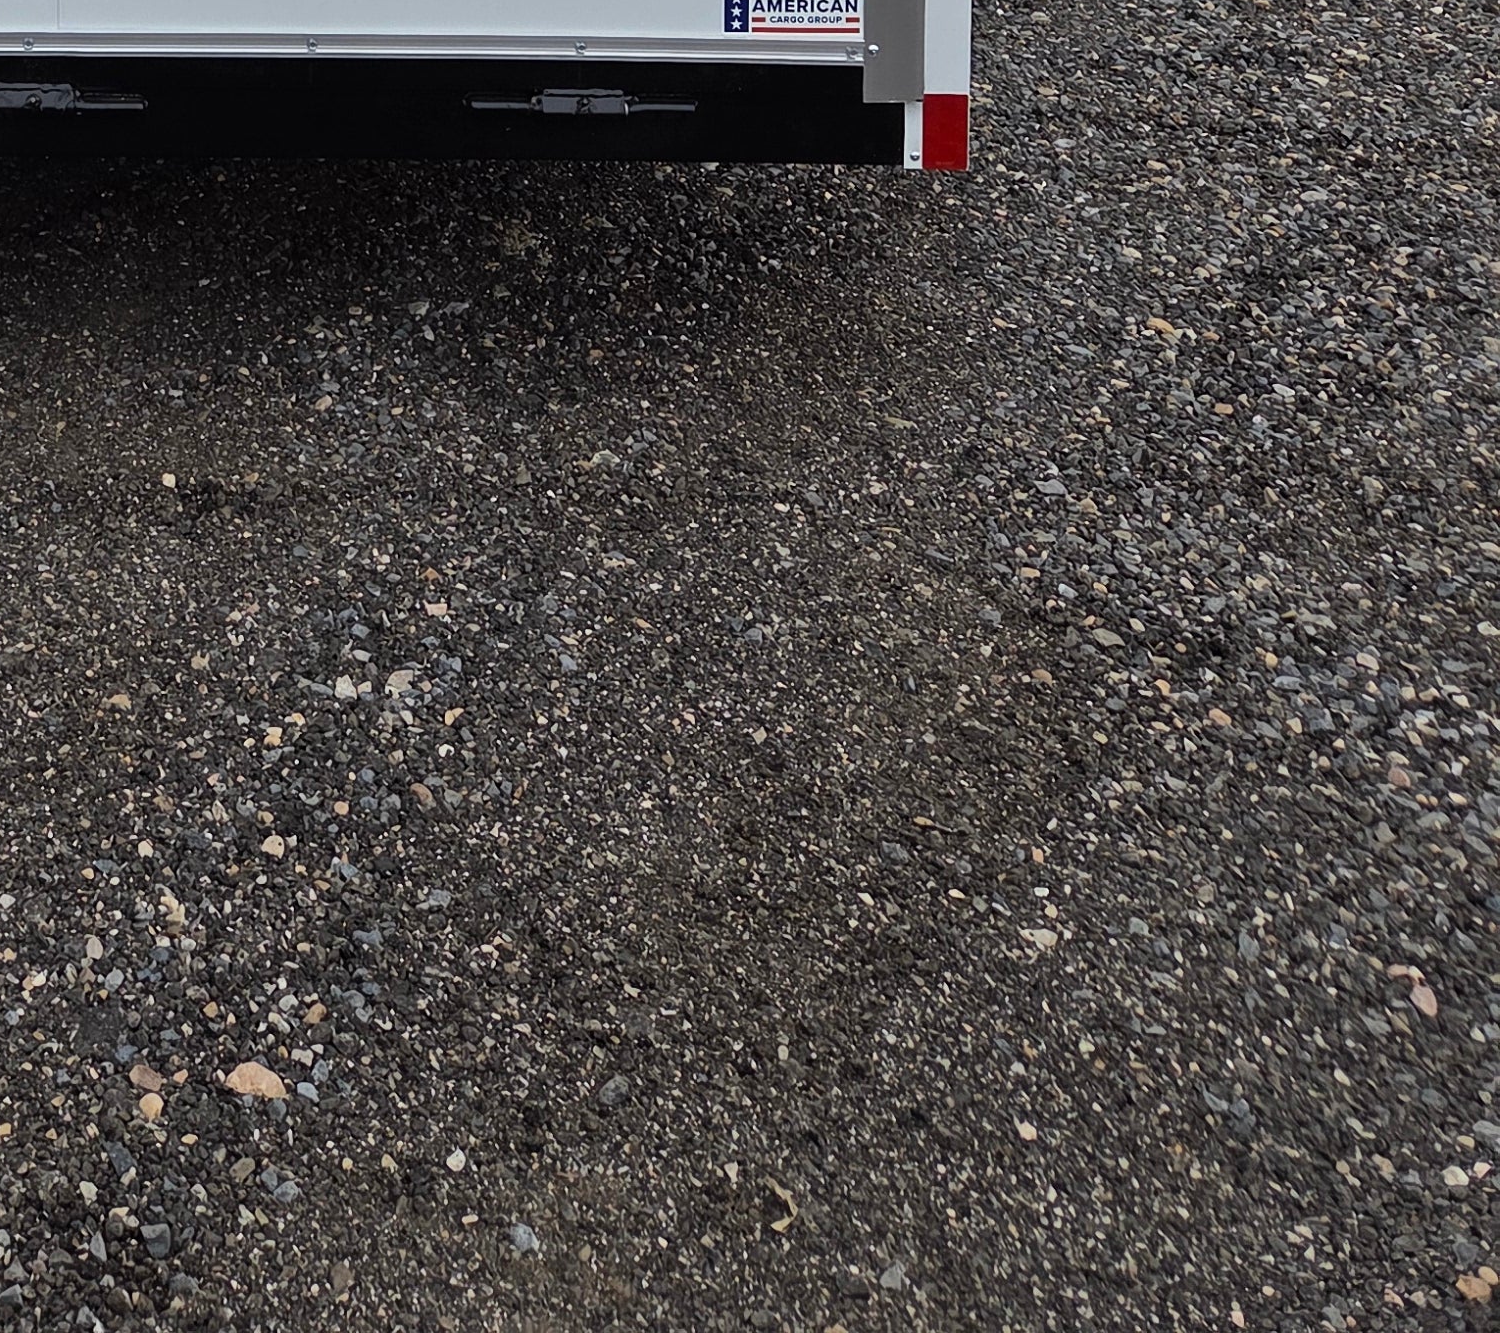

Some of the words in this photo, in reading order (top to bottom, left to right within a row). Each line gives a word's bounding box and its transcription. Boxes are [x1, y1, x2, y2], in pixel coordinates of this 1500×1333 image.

[752, 0, 858, 13] AMERICAN
[769, 16, 805, 24] CARGO
[807, 16, 843, 24] GROUP
